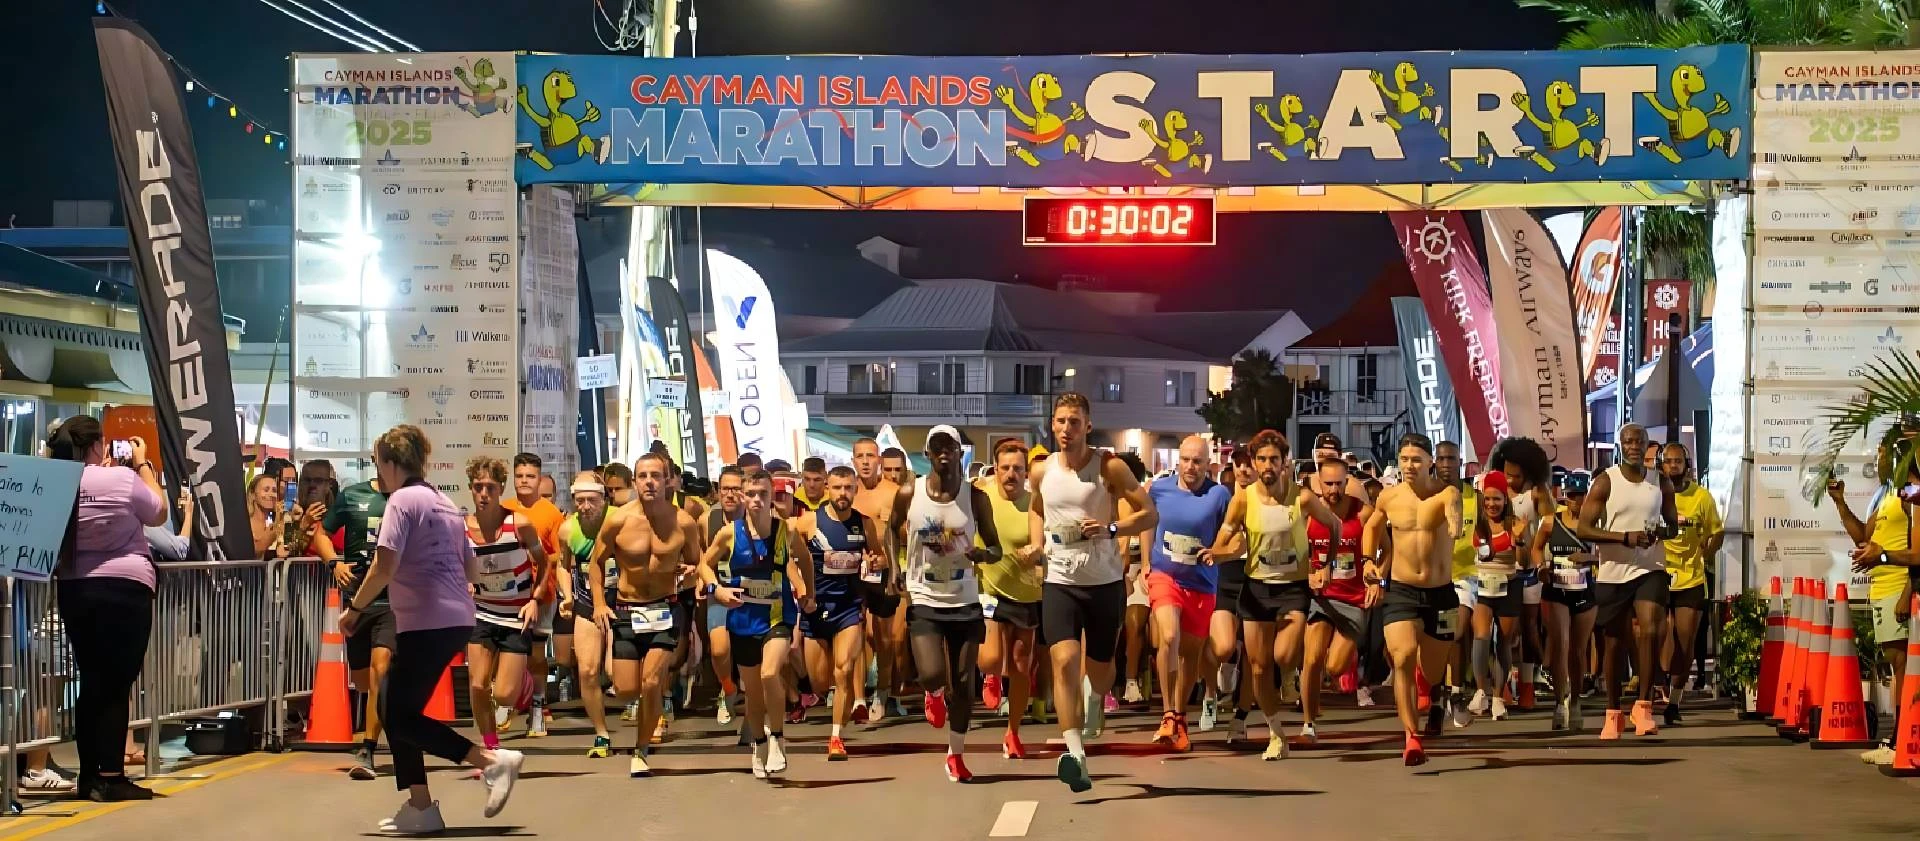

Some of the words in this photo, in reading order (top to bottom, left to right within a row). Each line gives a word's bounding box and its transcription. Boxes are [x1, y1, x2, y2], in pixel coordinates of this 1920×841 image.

[324, 69, 386, 82] CAYMAN
[389, 69, 453, 82] ISLANDS
[1784, 64, 1850, 78] CAYMAN
[313, 85, 460, 105] MARATHON
[631, 74, 803, 105] CAYMAN
[818, 74, 993, 107] ISLANDS
[1085, 64, 1658, 163] START
[347, 120, 432, 146] 2025
[610, 107, 1008, 168] MARATHON
[1808, 117, 1900, 143] 2025
[1068, 205, 1191, 235] 0:30:02
[1513, 228, 1542, 337] Airways
[732, 341, 762, 427] OPEN
[1463, 328, 1511, 441] FREEPOR
[1534, 346, 1560, 464] Cayman
[16, 545, 54, 574] RUN
